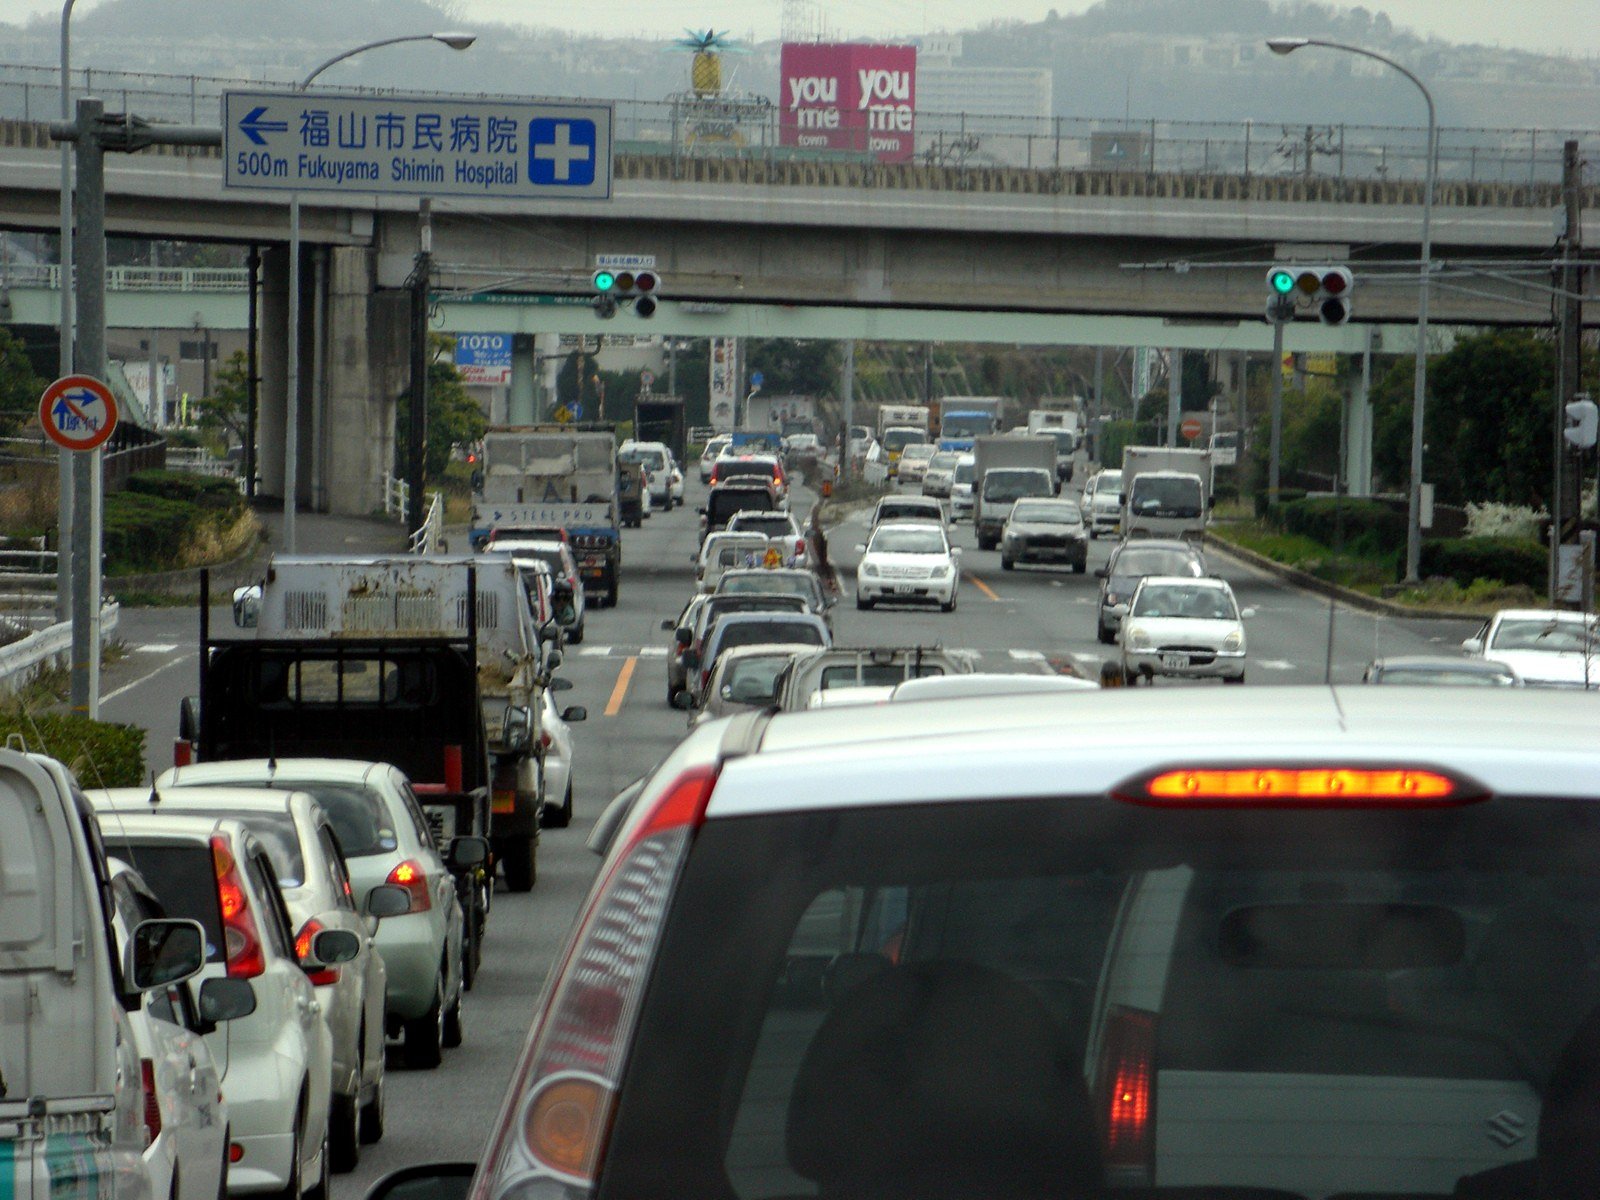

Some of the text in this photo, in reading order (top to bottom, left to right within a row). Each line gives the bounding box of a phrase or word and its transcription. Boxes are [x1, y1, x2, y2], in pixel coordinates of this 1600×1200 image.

[789, 77, 837, 112] you
[858, 69, 909, 111] you
[300, 109, 518, 154] 福山市民病院
[798, 107, 840, 129] me
[869, 104, 912, 131] me
[237, 151, 518, 189] 500m Fukuyama Shimin Hospital
[458, 335, 503, 350] TOTO
